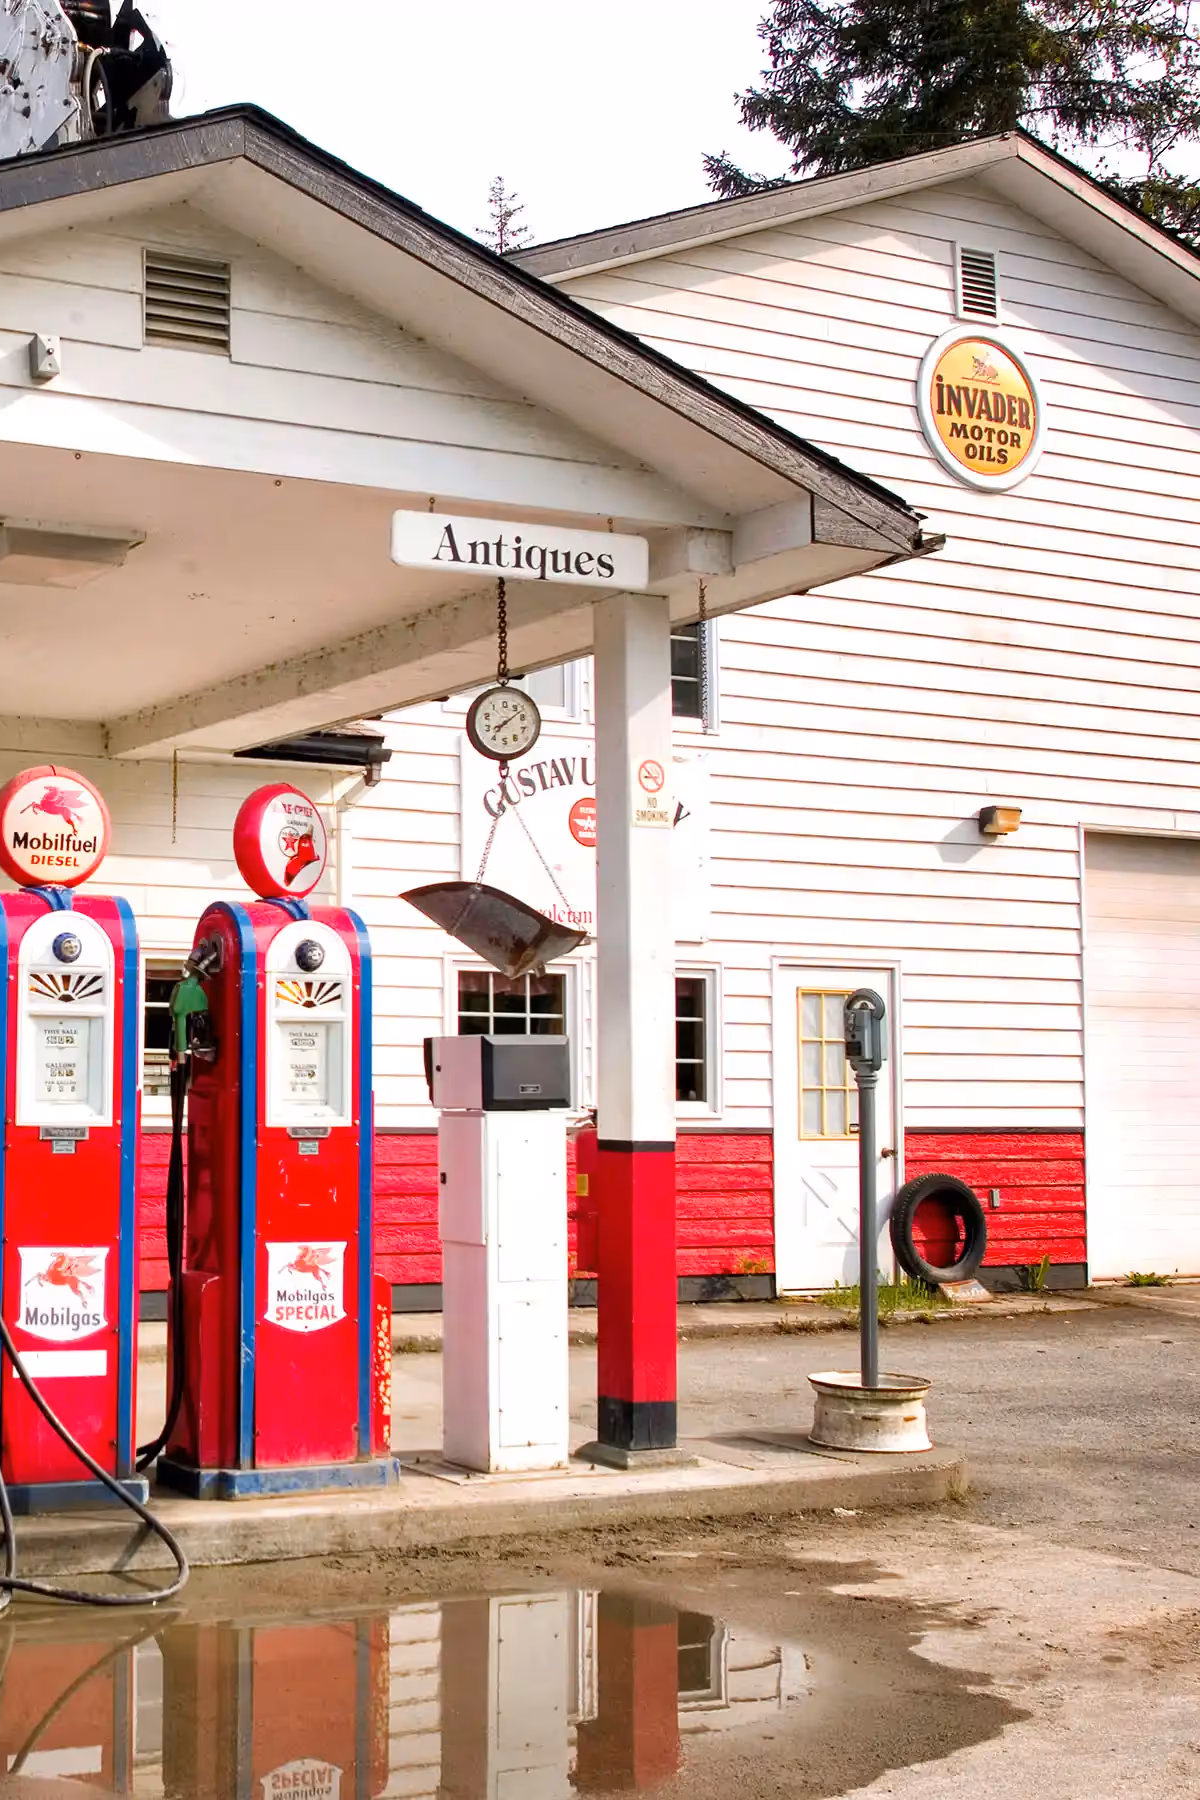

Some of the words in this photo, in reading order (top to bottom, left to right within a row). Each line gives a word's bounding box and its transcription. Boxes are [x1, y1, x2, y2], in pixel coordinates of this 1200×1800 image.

[949, 422, 1021, 449] MOTOR
[964, 443, 1009, 465] OILS
[431, 522, 615, 580] Antiques
[647, 797, 657, 808] NO
[636, 809, 669, 822] SMOKING
[12, 831, 97, 853] Mobilfuel
[30, 854, 80, 867] DIESEL
[276, 1289, 335, 1304] Mobilgas
[25, 1307, 101, 1331] Mobilgas
[275, 1305, 338, 1322] SPECIAL
